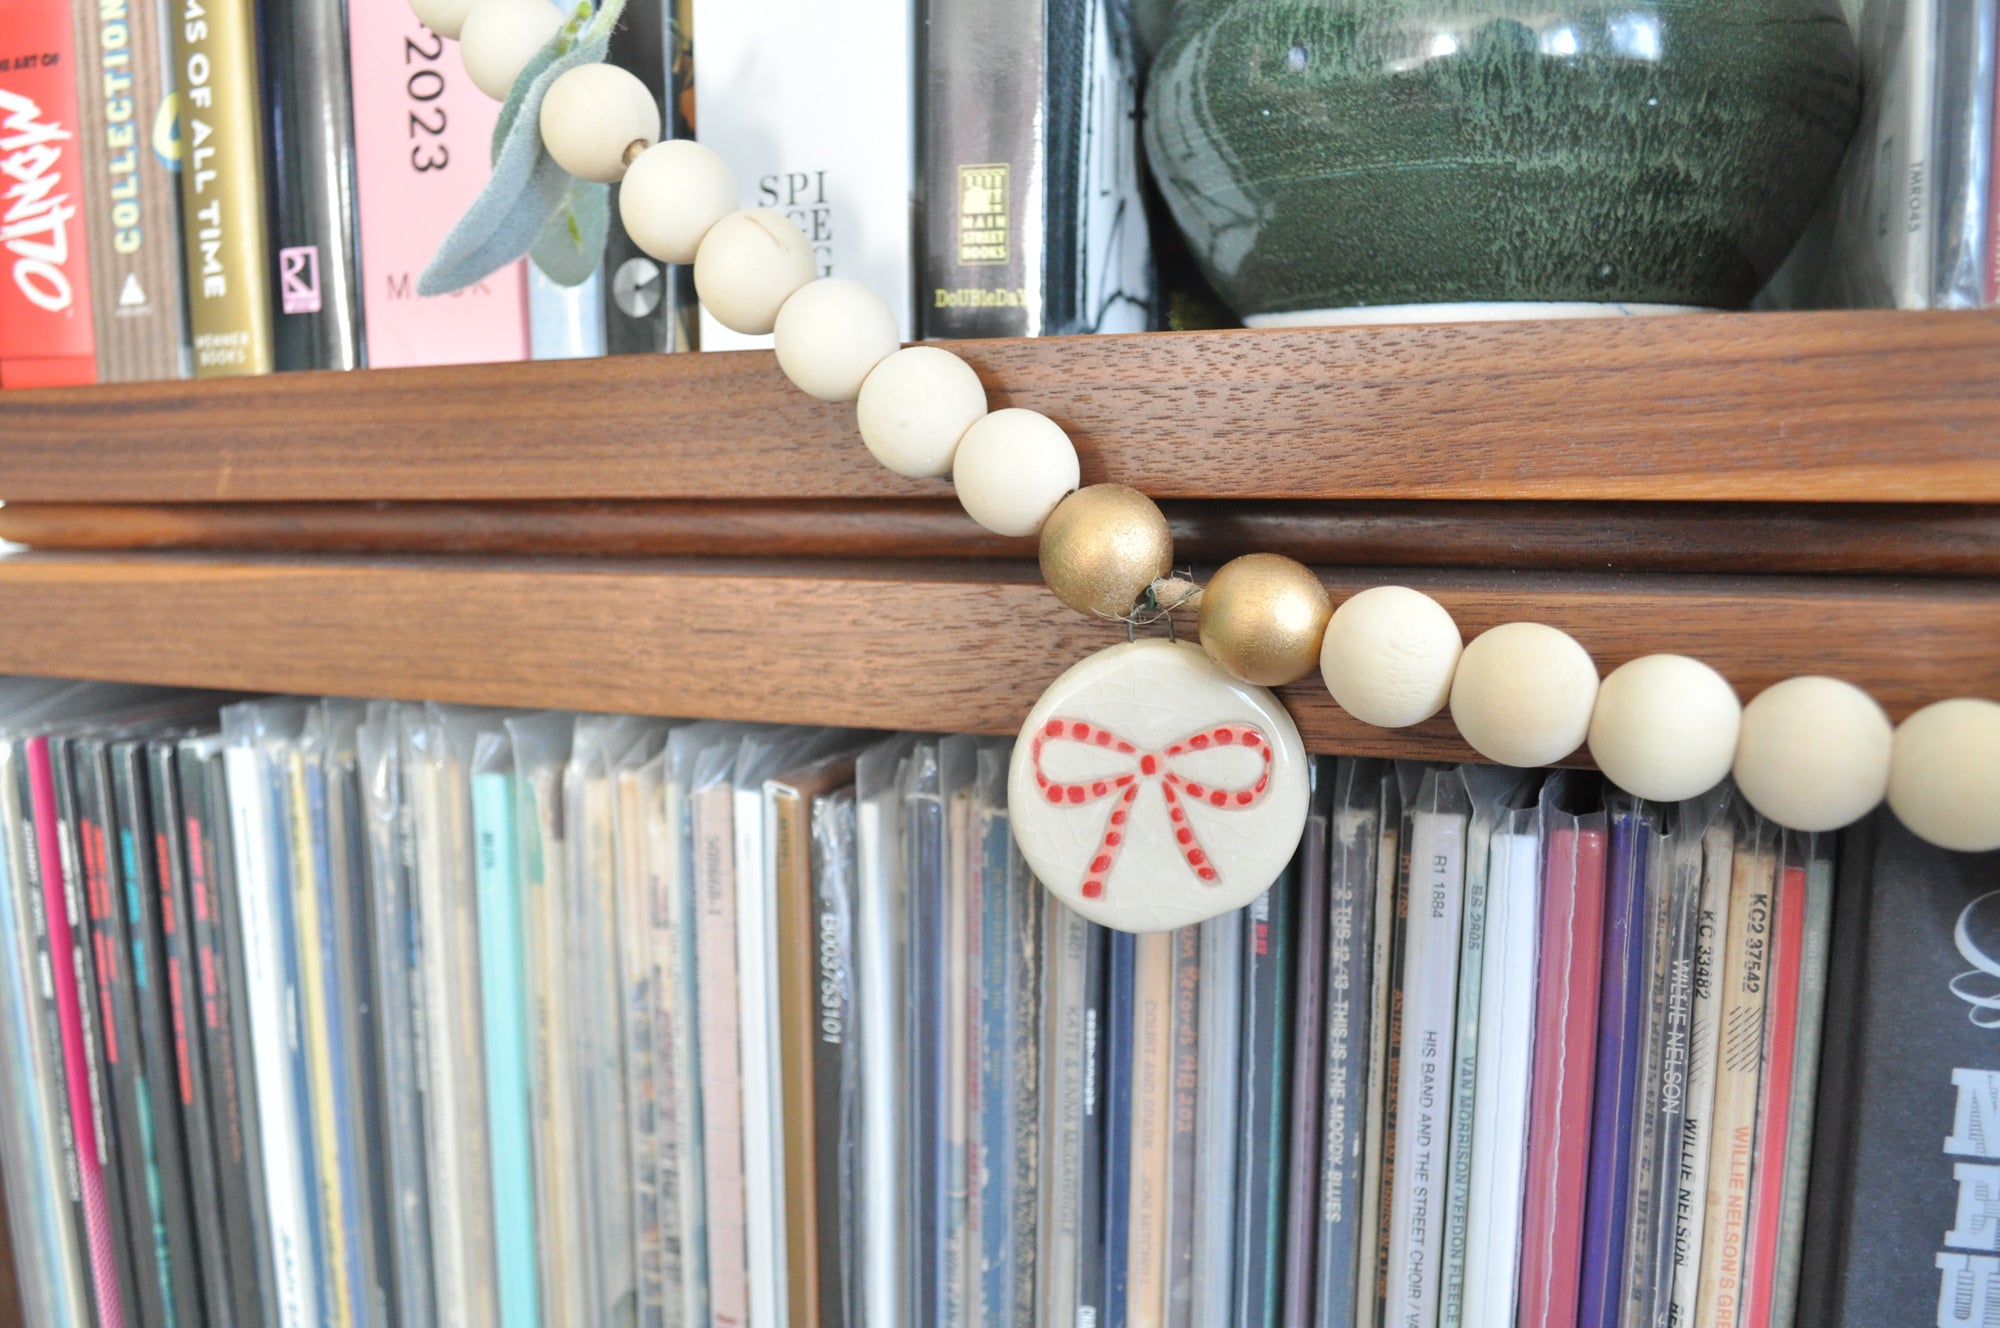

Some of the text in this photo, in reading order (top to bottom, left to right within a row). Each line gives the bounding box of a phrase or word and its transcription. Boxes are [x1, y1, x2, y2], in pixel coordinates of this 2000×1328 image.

[14, 55, 38, 70] ART
[41, 52, 61, 67] OF
[187, 53, 212, 109] OF
[100, 0, 143, 254] COLLECTION
[404, 36, 450, 173] 2023
[191, 120, 217, 193] ALL
[758, 169, 830, 208] SPI
[198, 200, 225, 298] TIME
[962, 214, 1006, 229] MAIN
[962, 230, 1006, 245] STREET
[962, 245, 1006, 260] BOOKS
[1432, 855, 1447, 919] R1 1884
[1470, 884, 1484, 911] BS
[1695, 909, 1715, 1000] KC 33482
[1744, 894, 1768, 994] KC2 37542
[1065, 1005, 1080, 1052] KATE
[1177, 965, 1200, 1046] Records
[1331, 1000, 1349, 1037] THIS
[1390, 988, 1404, 1048] ASTRAL
[1330, 1042, 1347, 1060] IS
[1421, 1030, 1437, 1057] HIS
[1661, 959, 1690, 1113] WILLIE NELSON
[1063, 1074, 1078, 1123] ANNA
[1329, 1064, 1347, 1100] THE
[1388, 1056, 1401, 1113] WEEKS
[1418, 1063, 1436, 1108] BAND
[1462, 1056, 1476, 1091] VAN
[1328, 1104, 1346, 1166] MOODY
[1416, 1113, 1434, 1147] AND
[1680, 1118, 1698, 1183] WILLIE
[1727, 1125, 1749, 1190] WILLIE
[1414, 1152, 1431, 1182] THE
[1325, 1168, 1344, 1223] BLUES
[1410, 1187, 1429, 1247] STREET
[1675, 1190, 1692, 1267] NELSON
[1720, 1195, 1744, 1290] NELSON'S
[1407, 1250, 1425, 1300] CHOIR
[1446, 1260, 1463, 1324] FLEECE
